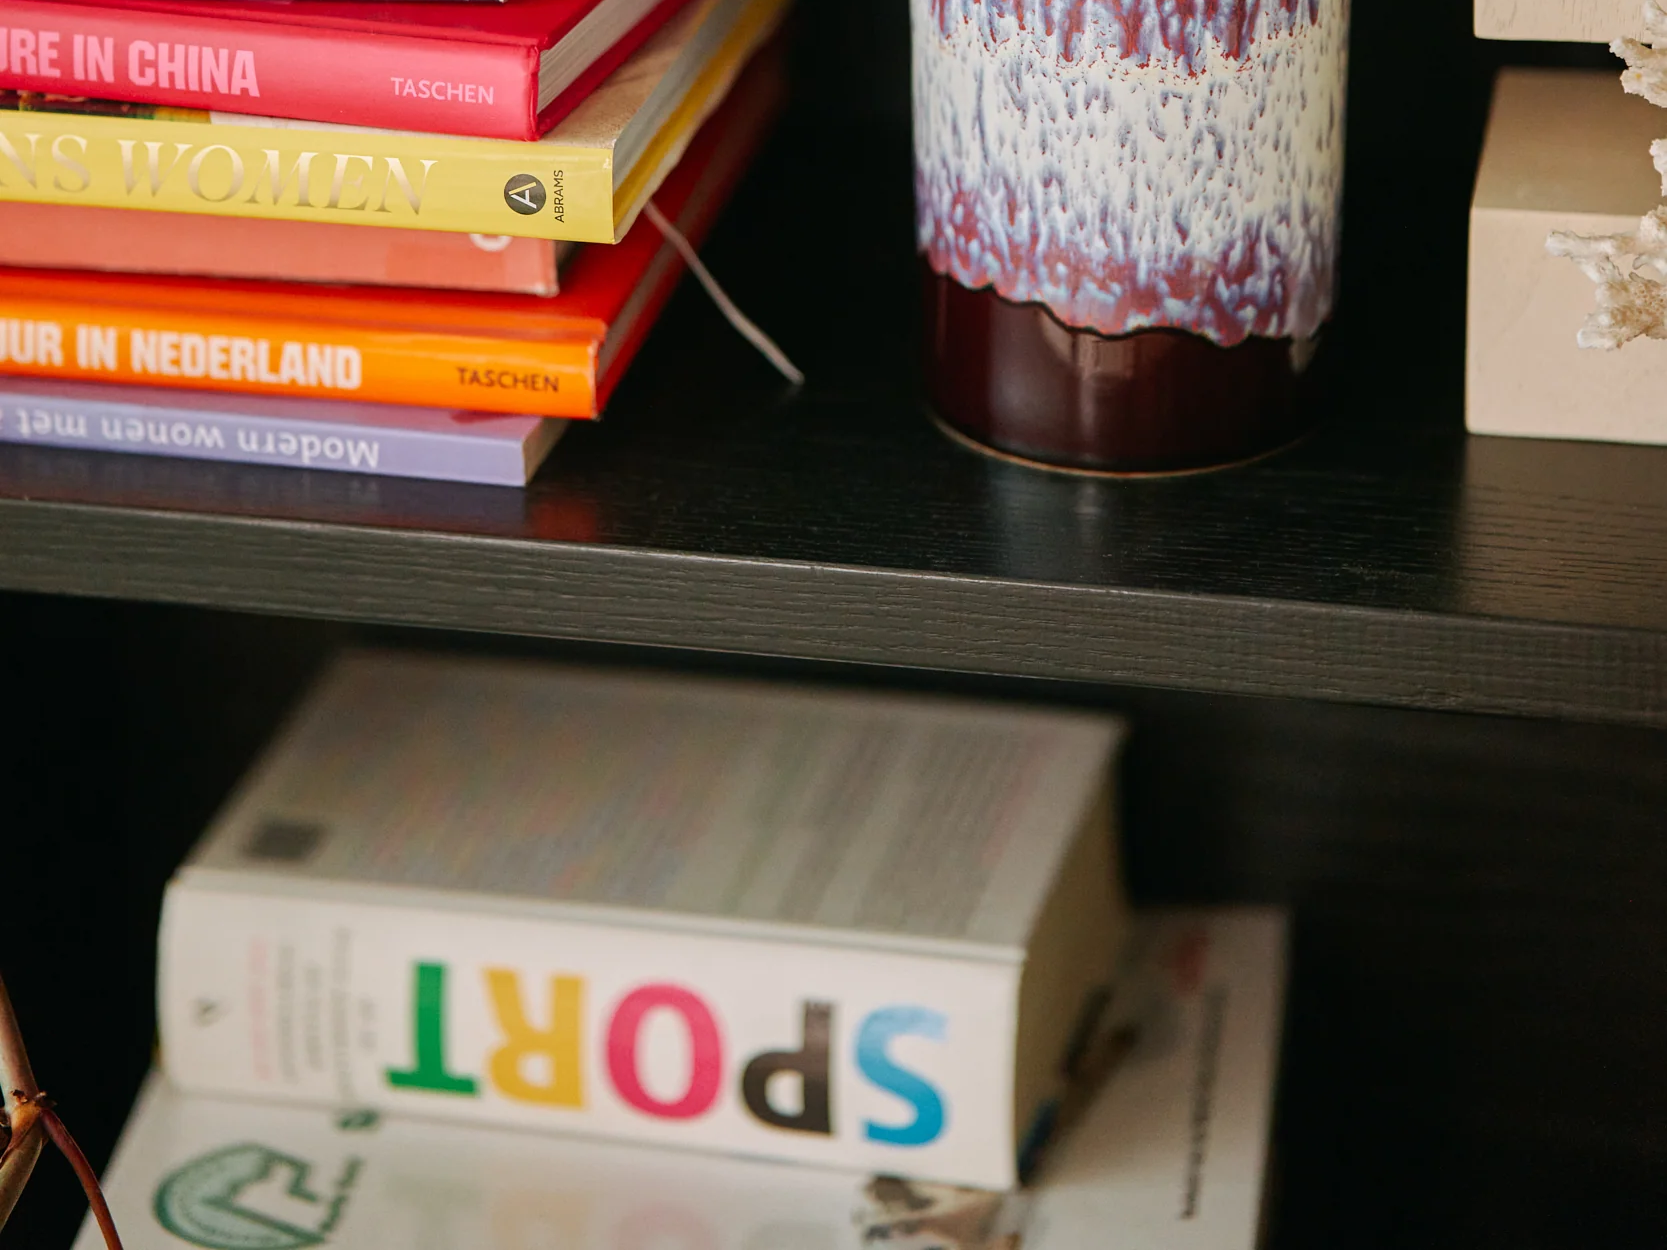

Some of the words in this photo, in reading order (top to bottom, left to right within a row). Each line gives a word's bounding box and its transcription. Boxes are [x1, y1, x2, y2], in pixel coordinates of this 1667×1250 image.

[73, 34, 115, 83] IN
[128, 40, 260, 98] CHINA
[390, 77, 495, 105] TASCHEN
[116, 139, 439, 216] WOMEN
[553, 169, 565, 223] ABRAMS
[76, 324, 119, 371] IN
[130, 329, 362, 390] NEDERLAND
[457, 366, 560, 393] TASCHEN
[17, 408, 88, 440] met
[102, 416, 225, 450] wonen
[237, 427, 380, 469] Modern
[386, 959, 948, 1147] SPORT
